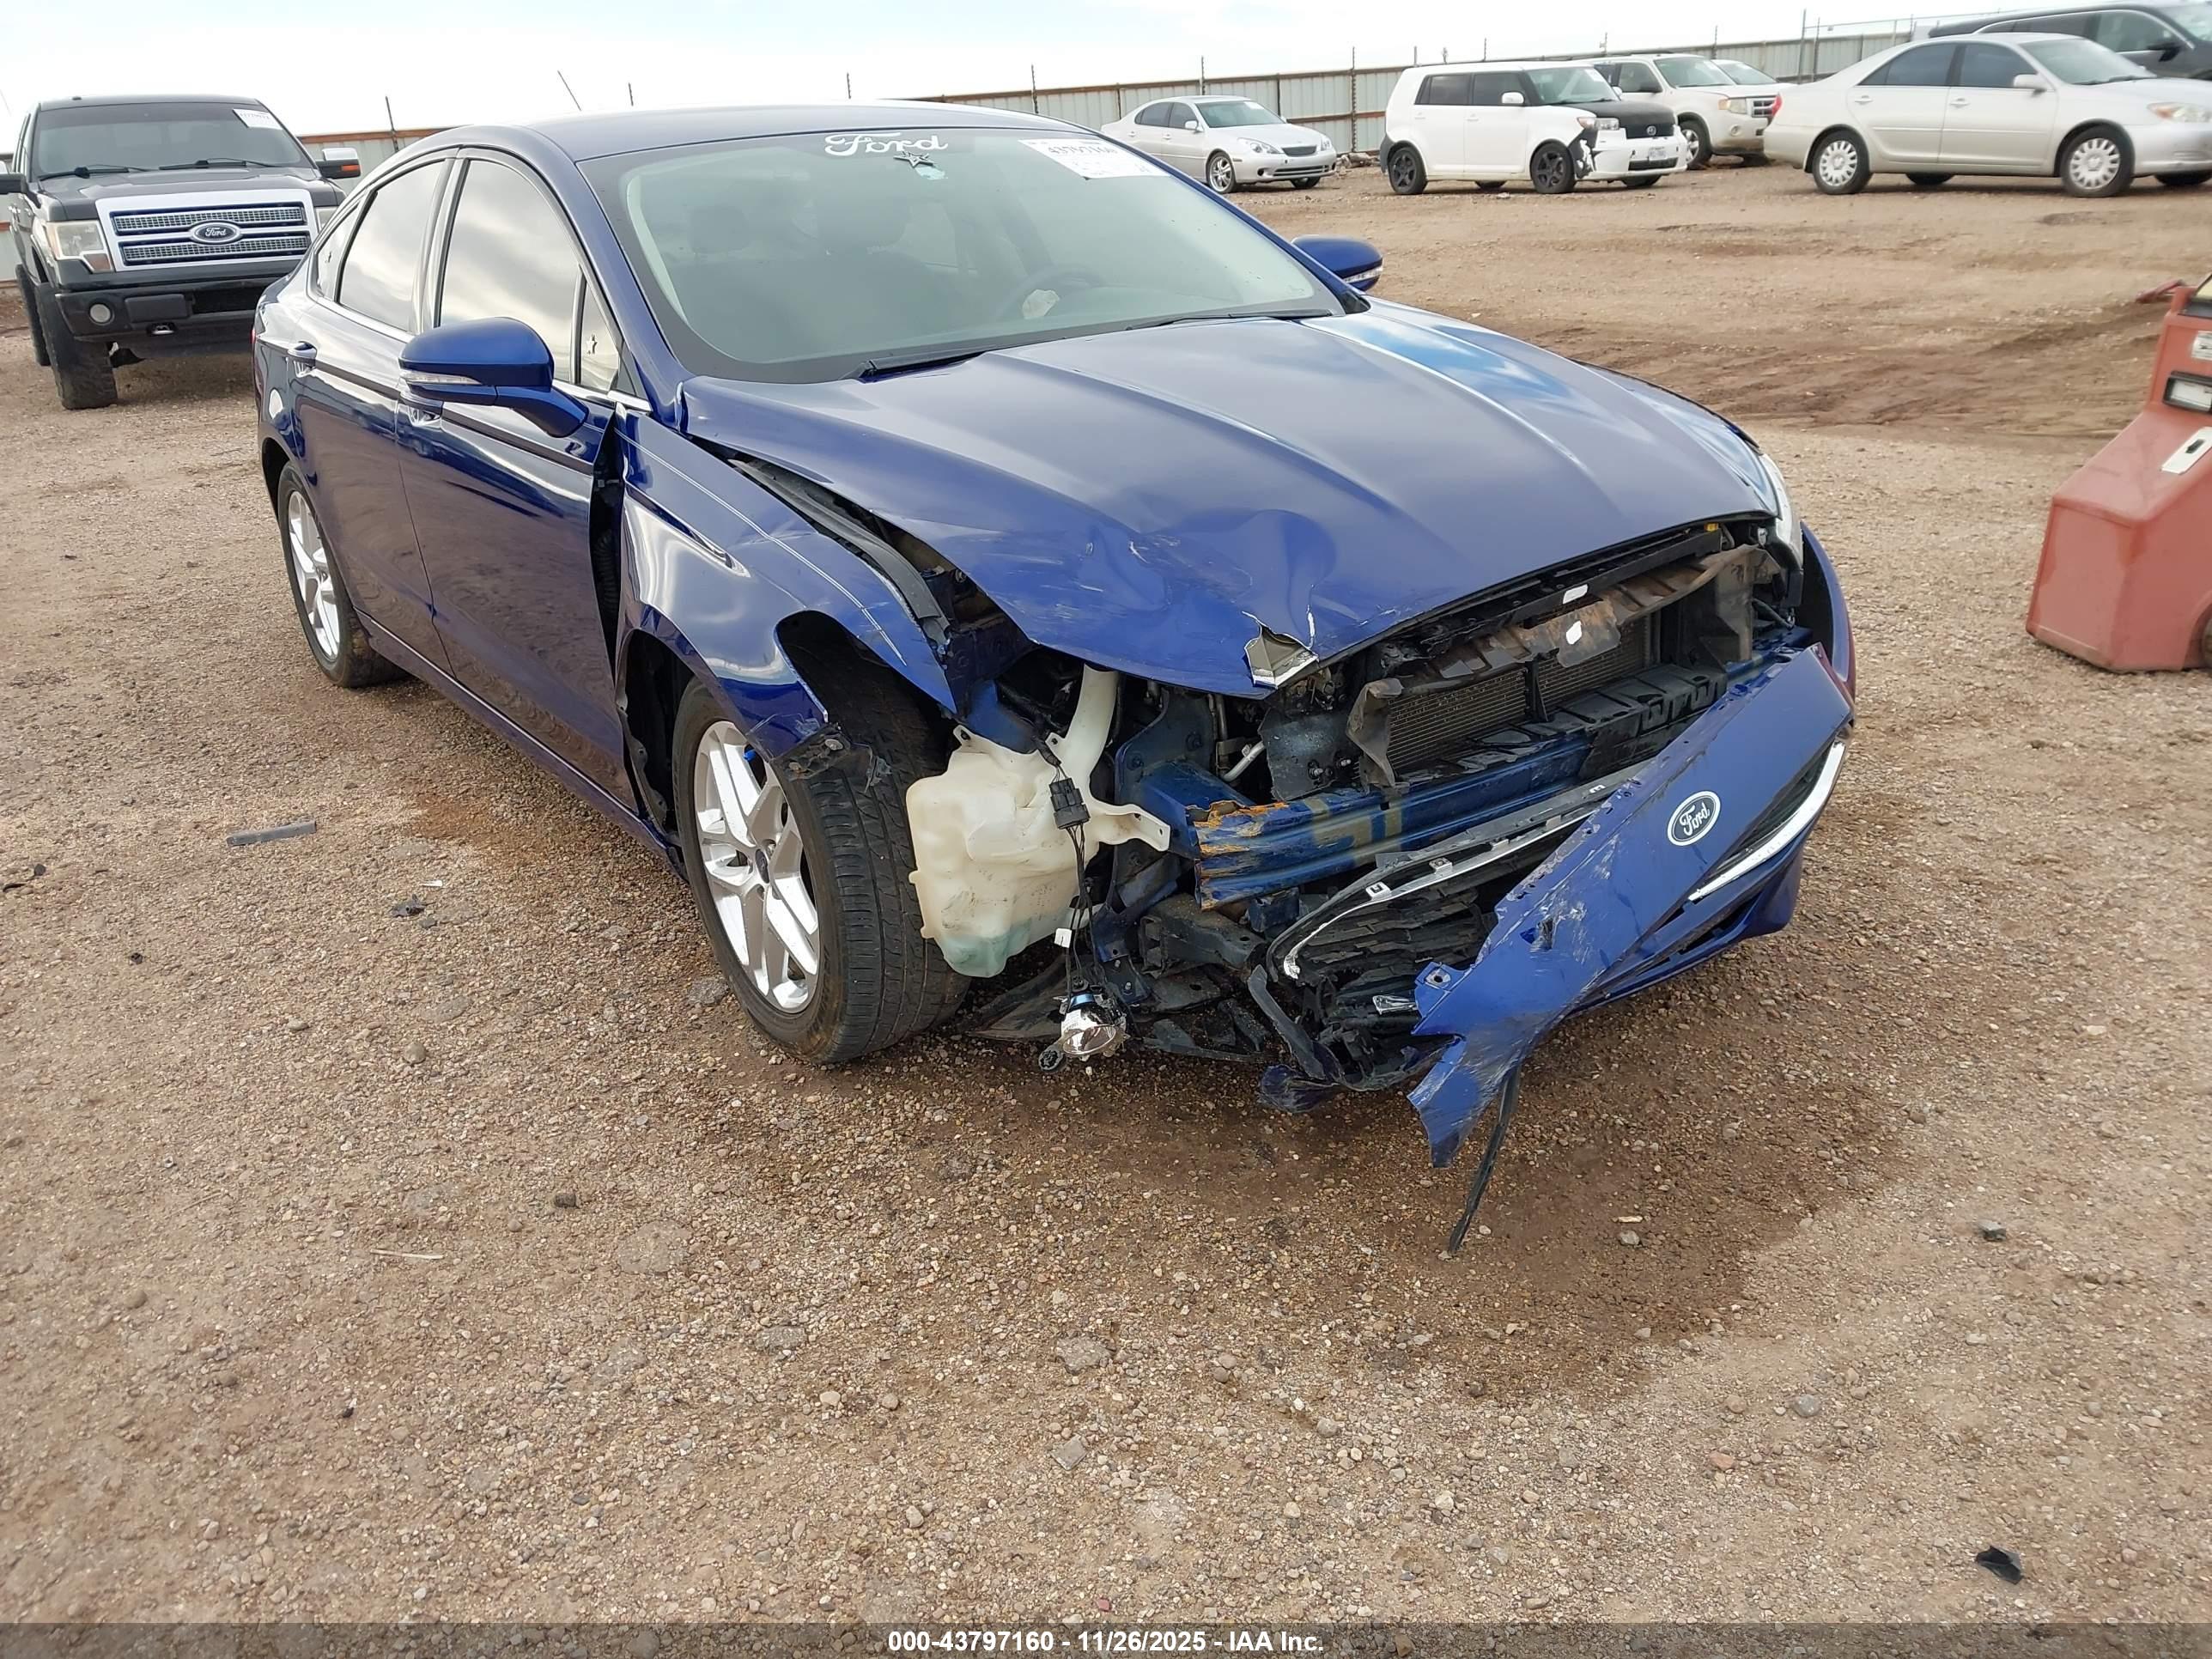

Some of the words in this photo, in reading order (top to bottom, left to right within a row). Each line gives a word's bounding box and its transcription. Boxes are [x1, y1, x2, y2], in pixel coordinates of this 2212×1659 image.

[824, 131, 949, 156] Ford
[204, 227, 227, 237] Ford
[1679, 801, 1711, 836] Ford
